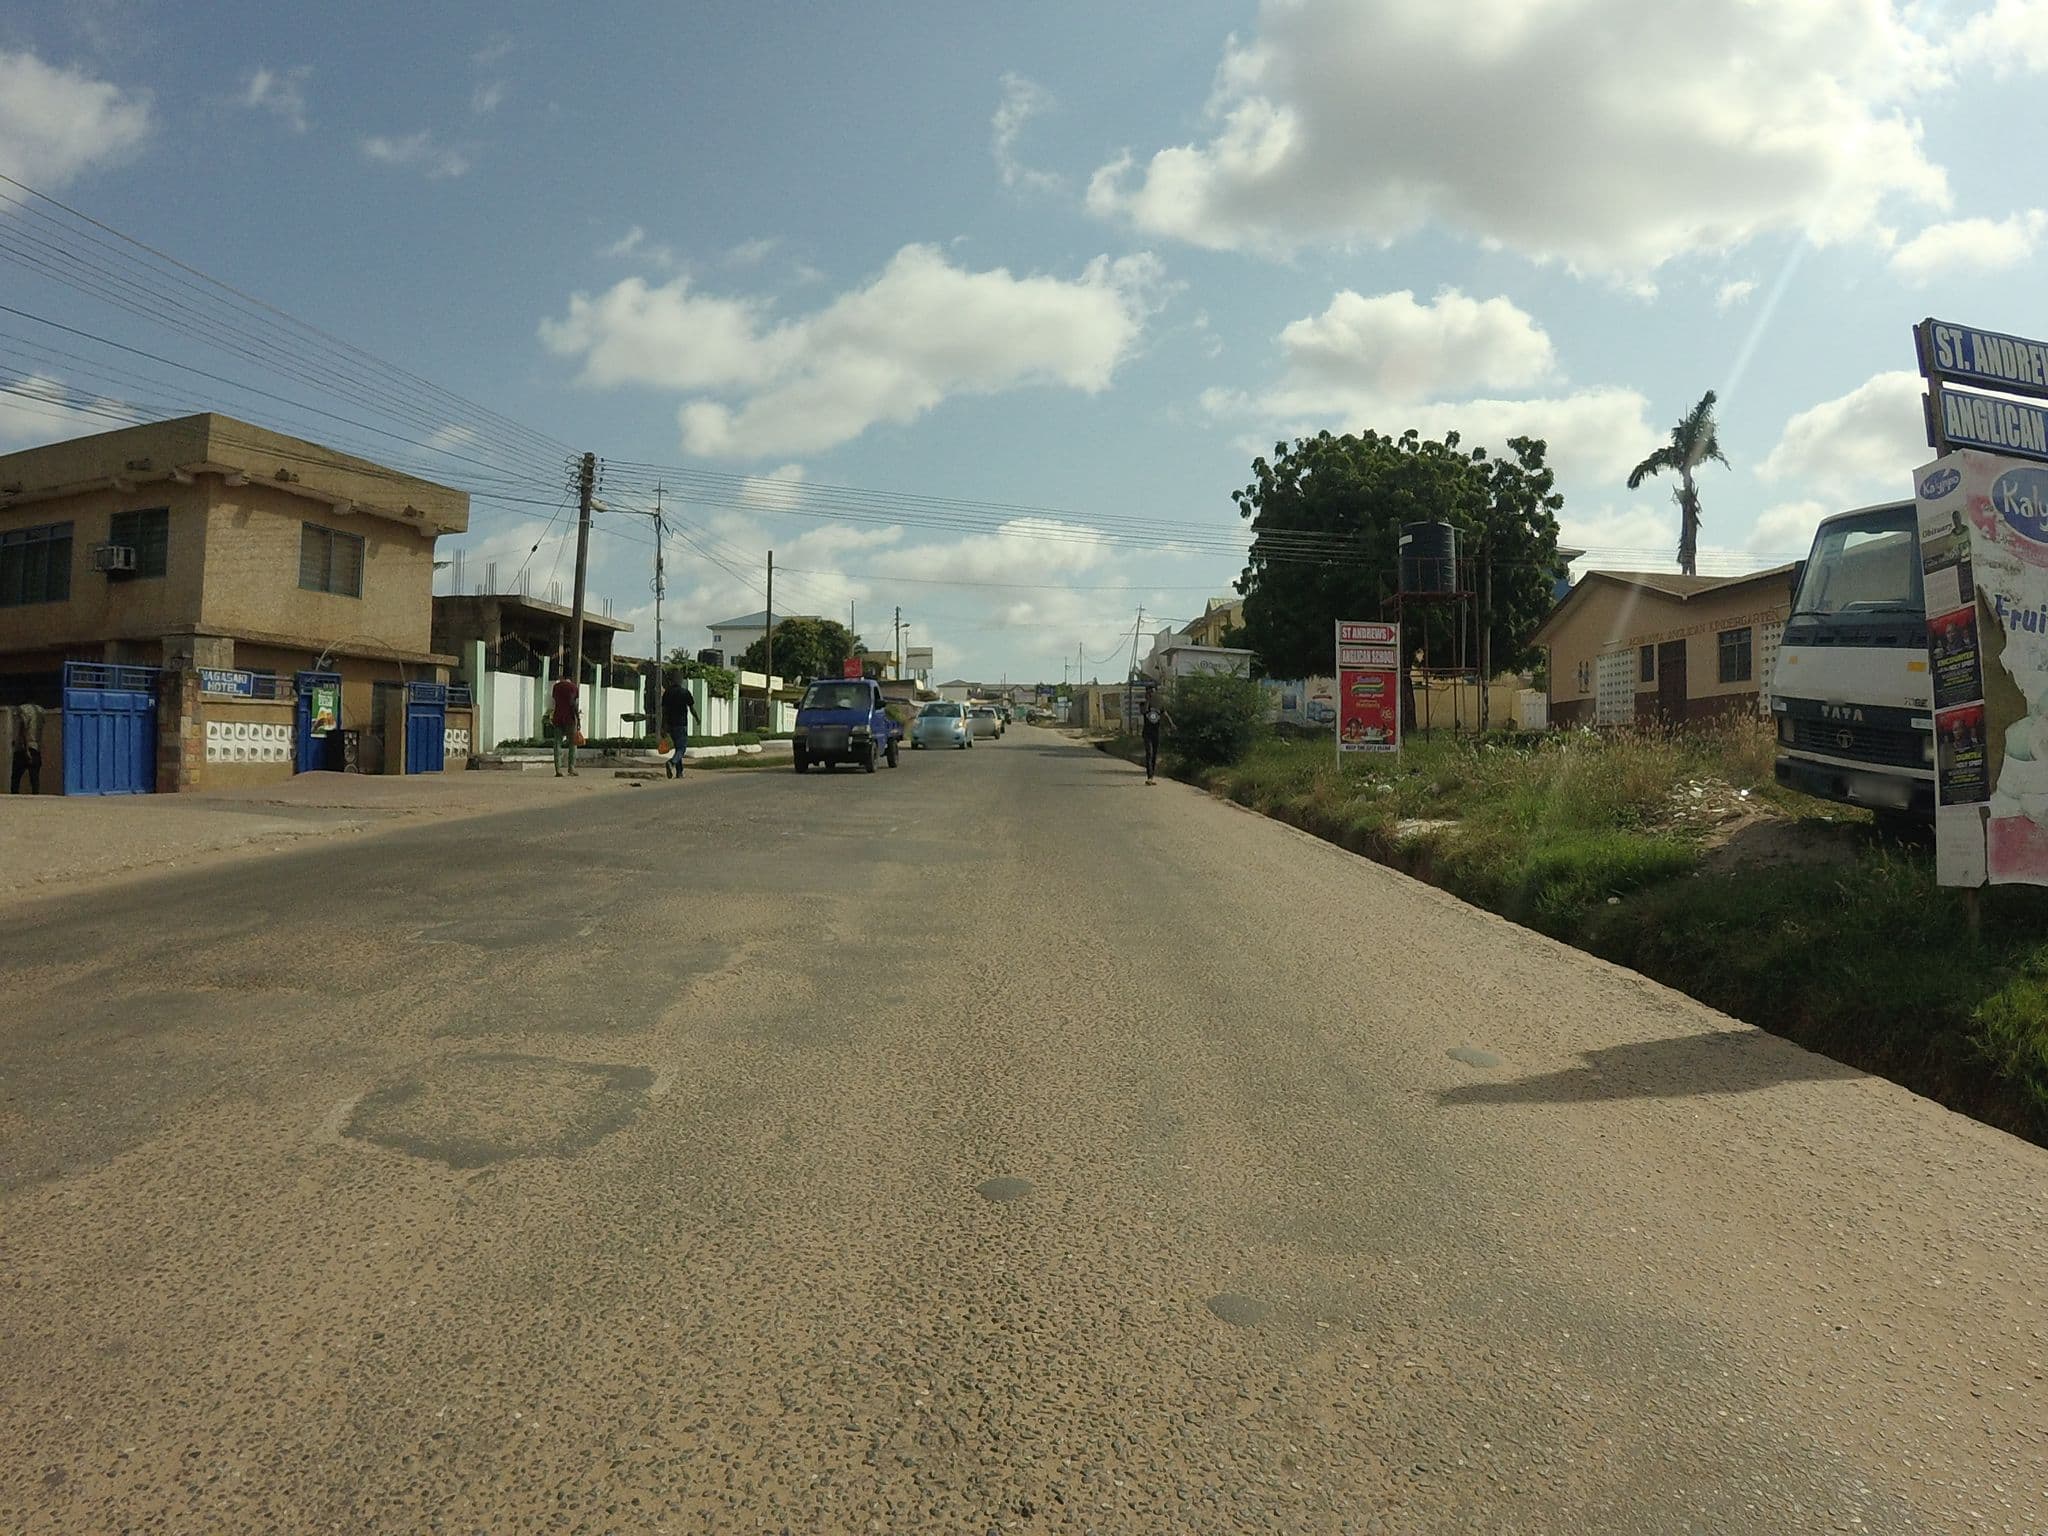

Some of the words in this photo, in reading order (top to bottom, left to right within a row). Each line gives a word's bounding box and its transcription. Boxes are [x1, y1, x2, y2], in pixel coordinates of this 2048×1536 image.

[1935, 325, 1970, 371] ST.
[1945, 394, 2047, 453] ANGLICAN
[1342, 626, 1352, 639] ST
[1821, 705, 1863, 721] TATA
